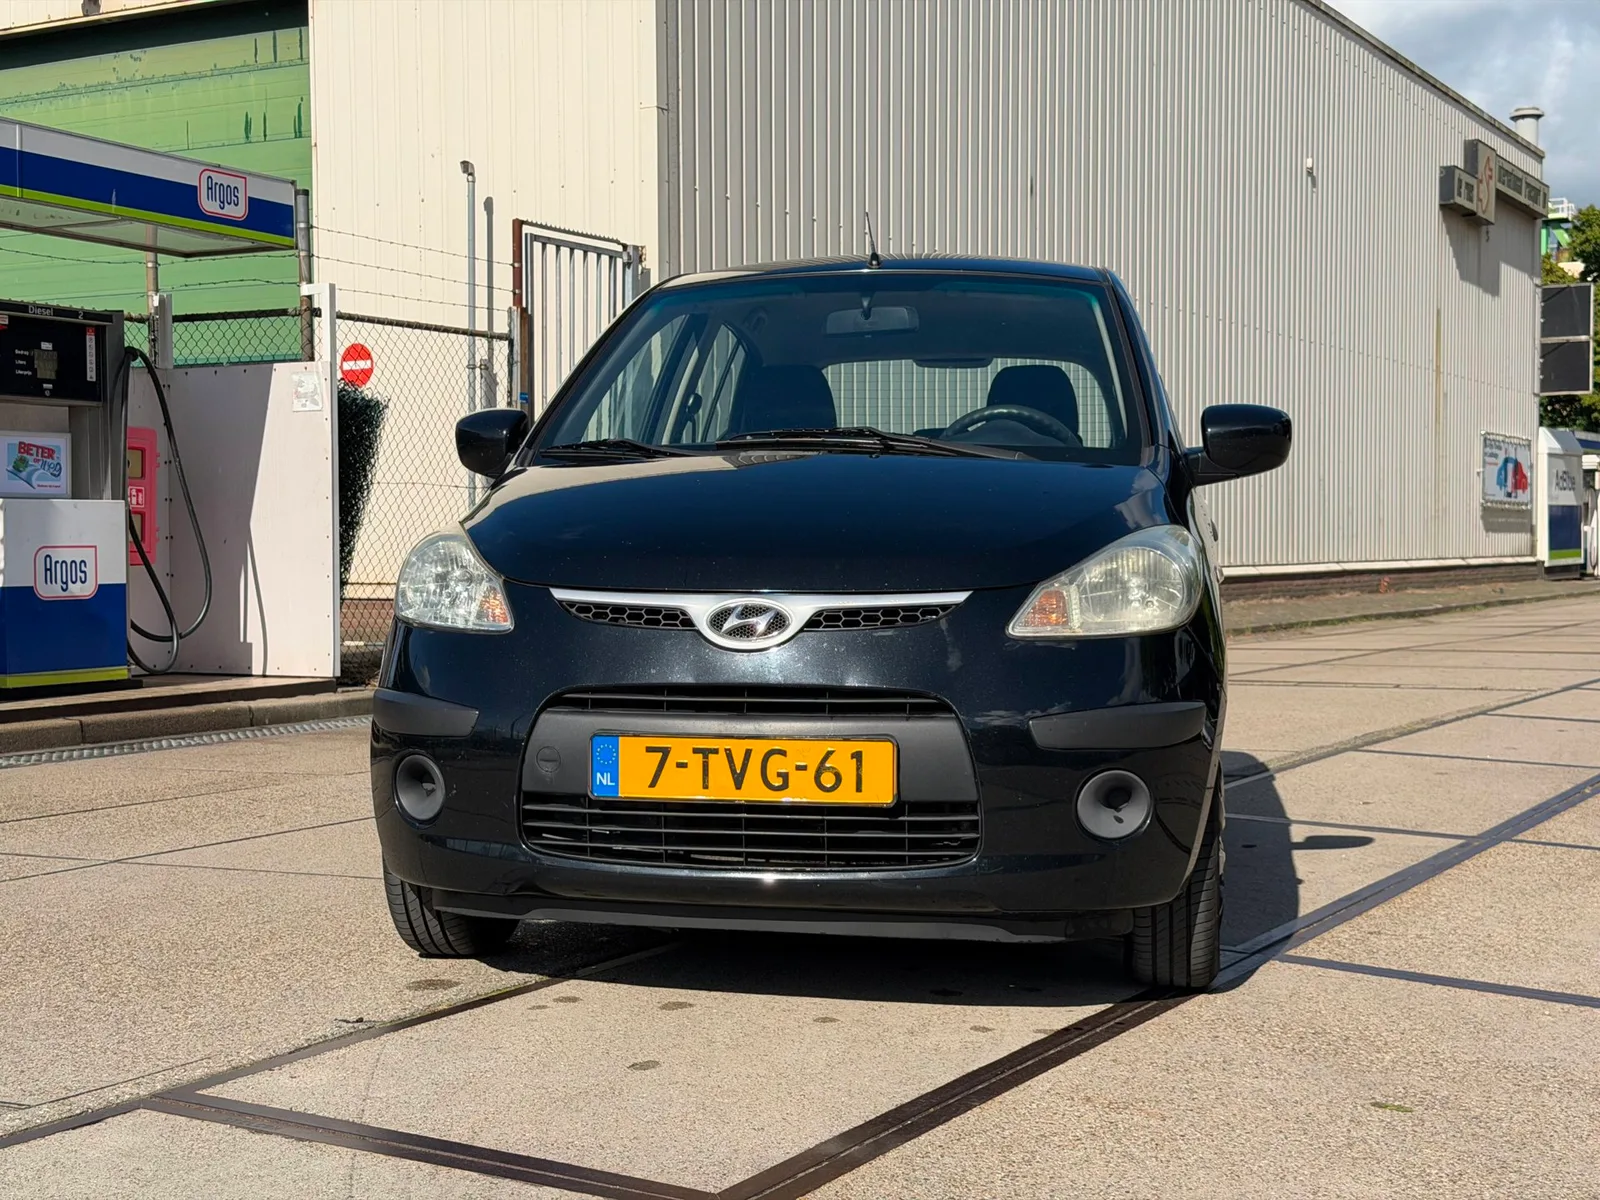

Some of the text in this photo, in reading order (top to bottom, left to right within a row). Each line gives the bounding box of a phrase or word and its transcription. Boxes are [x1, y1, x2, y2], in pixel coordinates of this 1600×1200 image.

[206, 175, 240, 210] Argos
[28, 305, 84, 320] Diesel 2
[18, 440, 56, 460] BETER
[44, 554, 88, 592] Argos
[596, 773, 616, 787] NL
[645, 746, 864, 793] 7-TVG-61
